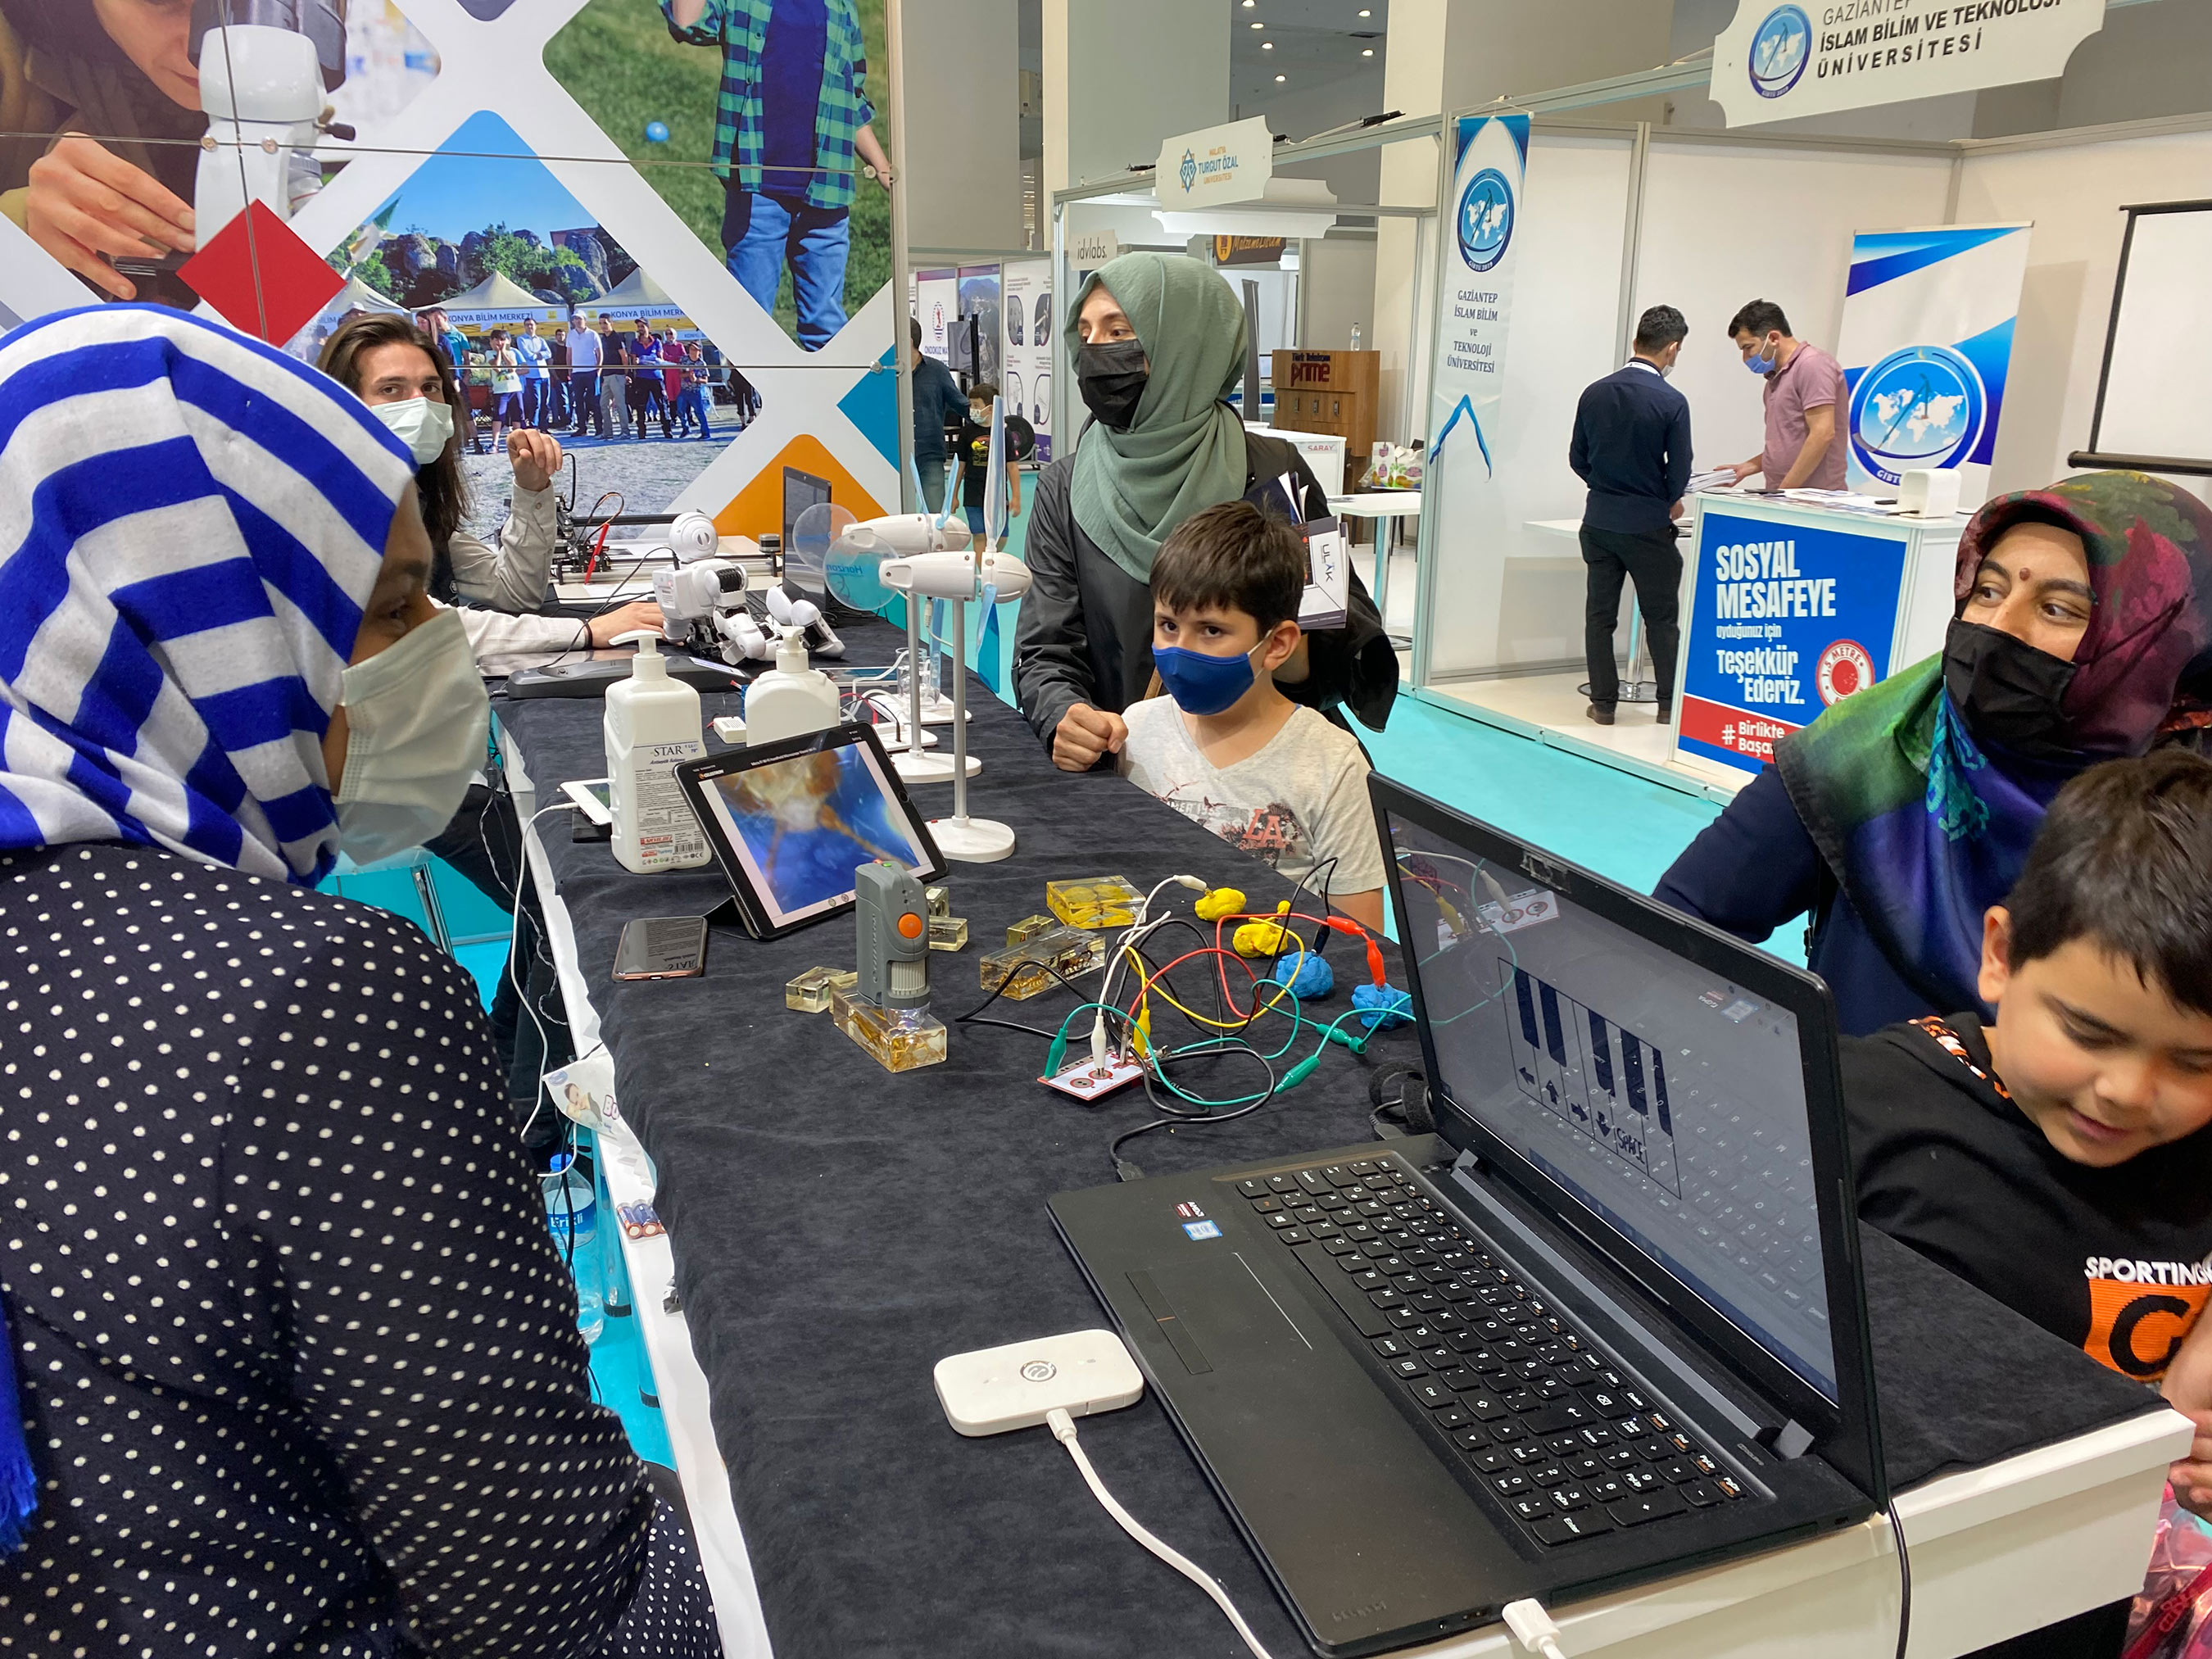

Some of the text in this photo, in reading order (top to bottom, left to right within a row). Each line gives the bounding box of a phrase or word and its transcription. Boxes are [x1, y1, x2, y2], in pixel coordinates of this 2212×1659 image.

[1820, 26, 1869, 52] İSLAM
[1872, 15, 1920, 42] BİLİM
[1925, 10, 1948, 31] VE
[1817, 27, 1983, 79] ÜNİVERSİTESİ
[1198, 155, 1239, 175] TURGUT ÖZAL
[1457, 289, 1498, 303] GAZİANTEP
[475, 312, 497, 322] BİLİM
[610, 310, 637, 319] KONYA
[640, 309, 661, 317] BİLİM
[1454, 304, 1498, 321] İSLAM BİLİM
[1454, 340, 1492, 357] TEKNOLOJİ
[1447, 354, 1495, 373] ÜNİVERSİTESİ
[1716, 540, 1801, 582] SOSYAL
[1716, 578, 1836, 619] MESAFEYE
[1716, 623, 1782, 642] uyduğunuz için
[1716, 644, 1798, 683] Teşekkür
[1832, 647, 1861, 662] METRE
[1744, 675, 1806, 705] Ederiz.
[1738, 720, 1785, 739] Birlikte
[654, 746, 683, 757] STAR
[1738, 737, 1774, 757] Başa
[1241, 809, 1286, 849] LA
